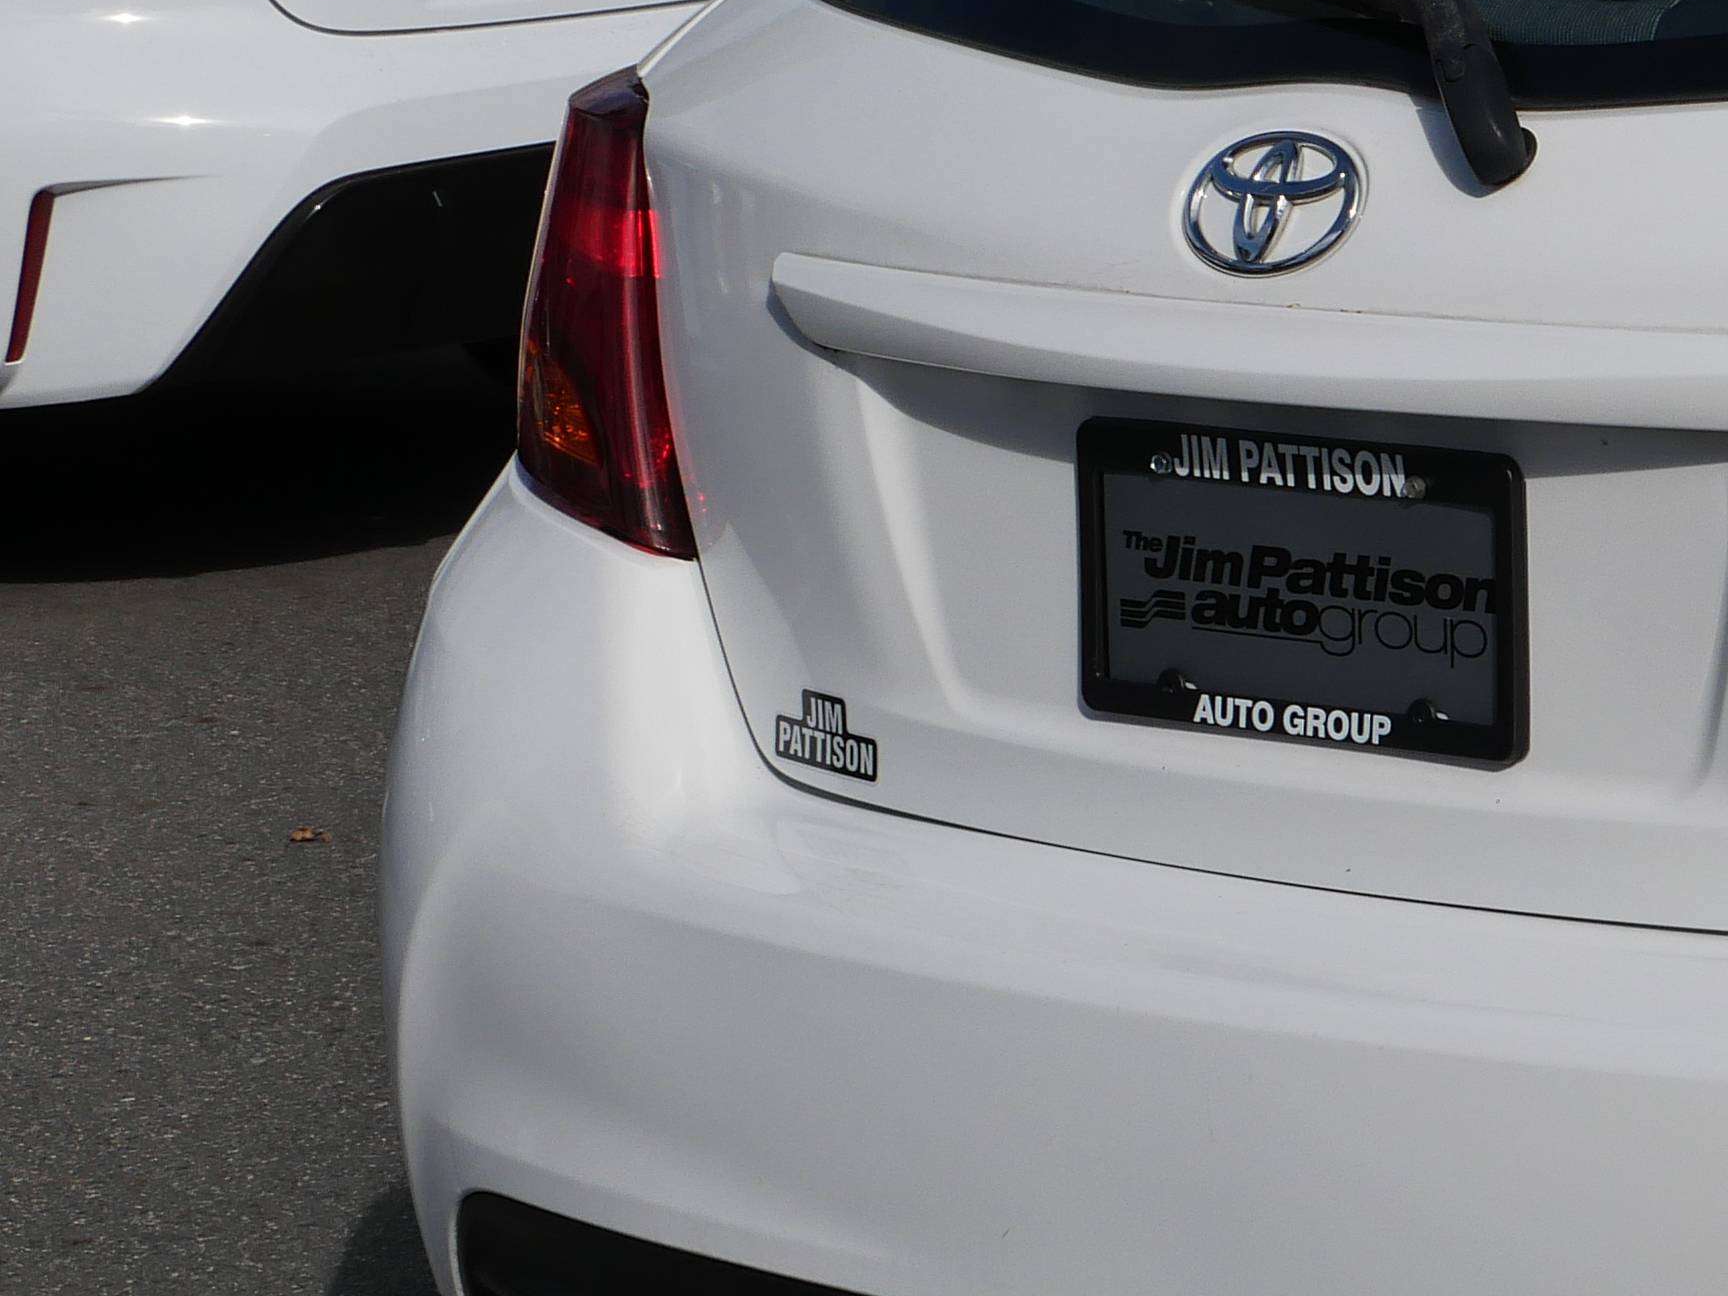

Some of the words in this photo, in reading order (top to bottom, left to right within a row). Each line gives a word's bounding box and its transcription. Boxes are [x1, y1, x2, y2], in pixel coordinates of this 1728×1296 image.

[1174, 434, 1230, 481] JIM
[1239, 439, 1407, 498] PATTISON
[1123, 530, 1163, 553] The
[806, 697, 843, 735] JIM
[1193, 694, 1274, 732] AUTO
[1283, 705, 1392, 745] GROUP
[779, 720, 874, 776] PATTISON
